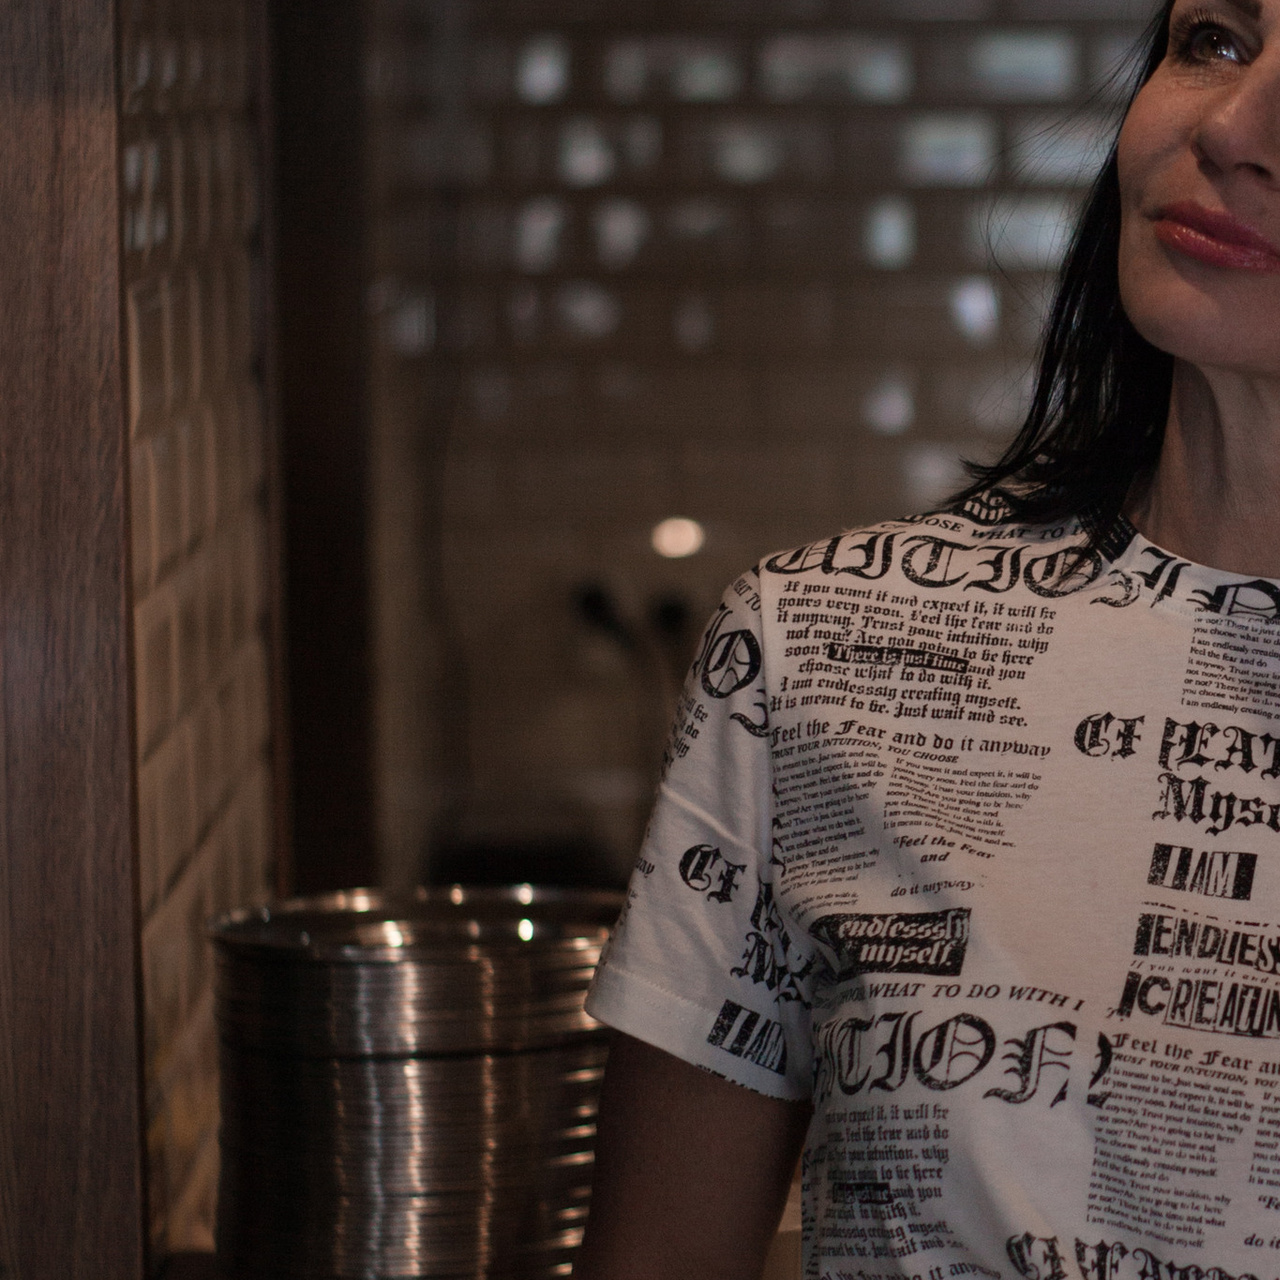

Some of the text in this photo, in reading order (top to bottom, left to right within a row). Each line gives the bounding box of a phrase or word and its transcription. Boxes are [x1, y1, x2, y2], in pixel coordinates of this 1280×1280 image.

[785, 697, 796, 709] is
[801, 695, 846, 708] meant
[850, 698, 864, 710] to
[869, 700, 888, 713] be.
[894, 701, 928, 718] Just
[931, 706, 963, 720] wait
[968, 709, 994, 722] and
[1000, 713, 1028, 726] see.
[770, 720, 1050, 760] Feel the Fear and do it anyway
[772, 738, 958, 763] TRUST YOUR INTUITION, YOU CHOOSE
[920, 852, 950, 862] and
[1188, 850, 1239, 899] AM
[860, 940, 951, 966] myself.
[869, 983, 1070, 1009] WHAT TO DO WITH
[1112, 1033, 1157, 1053] Feel
[1165, 1044, 1192, 1059] the
[1200, 1050, 1252, 1071] Fear
[1150, 1059, 1180, 1072] YOUR
[1183, 1064, 1248, 1085] INTUITION,
[1256, 1078, 1277, 1088] YOU
